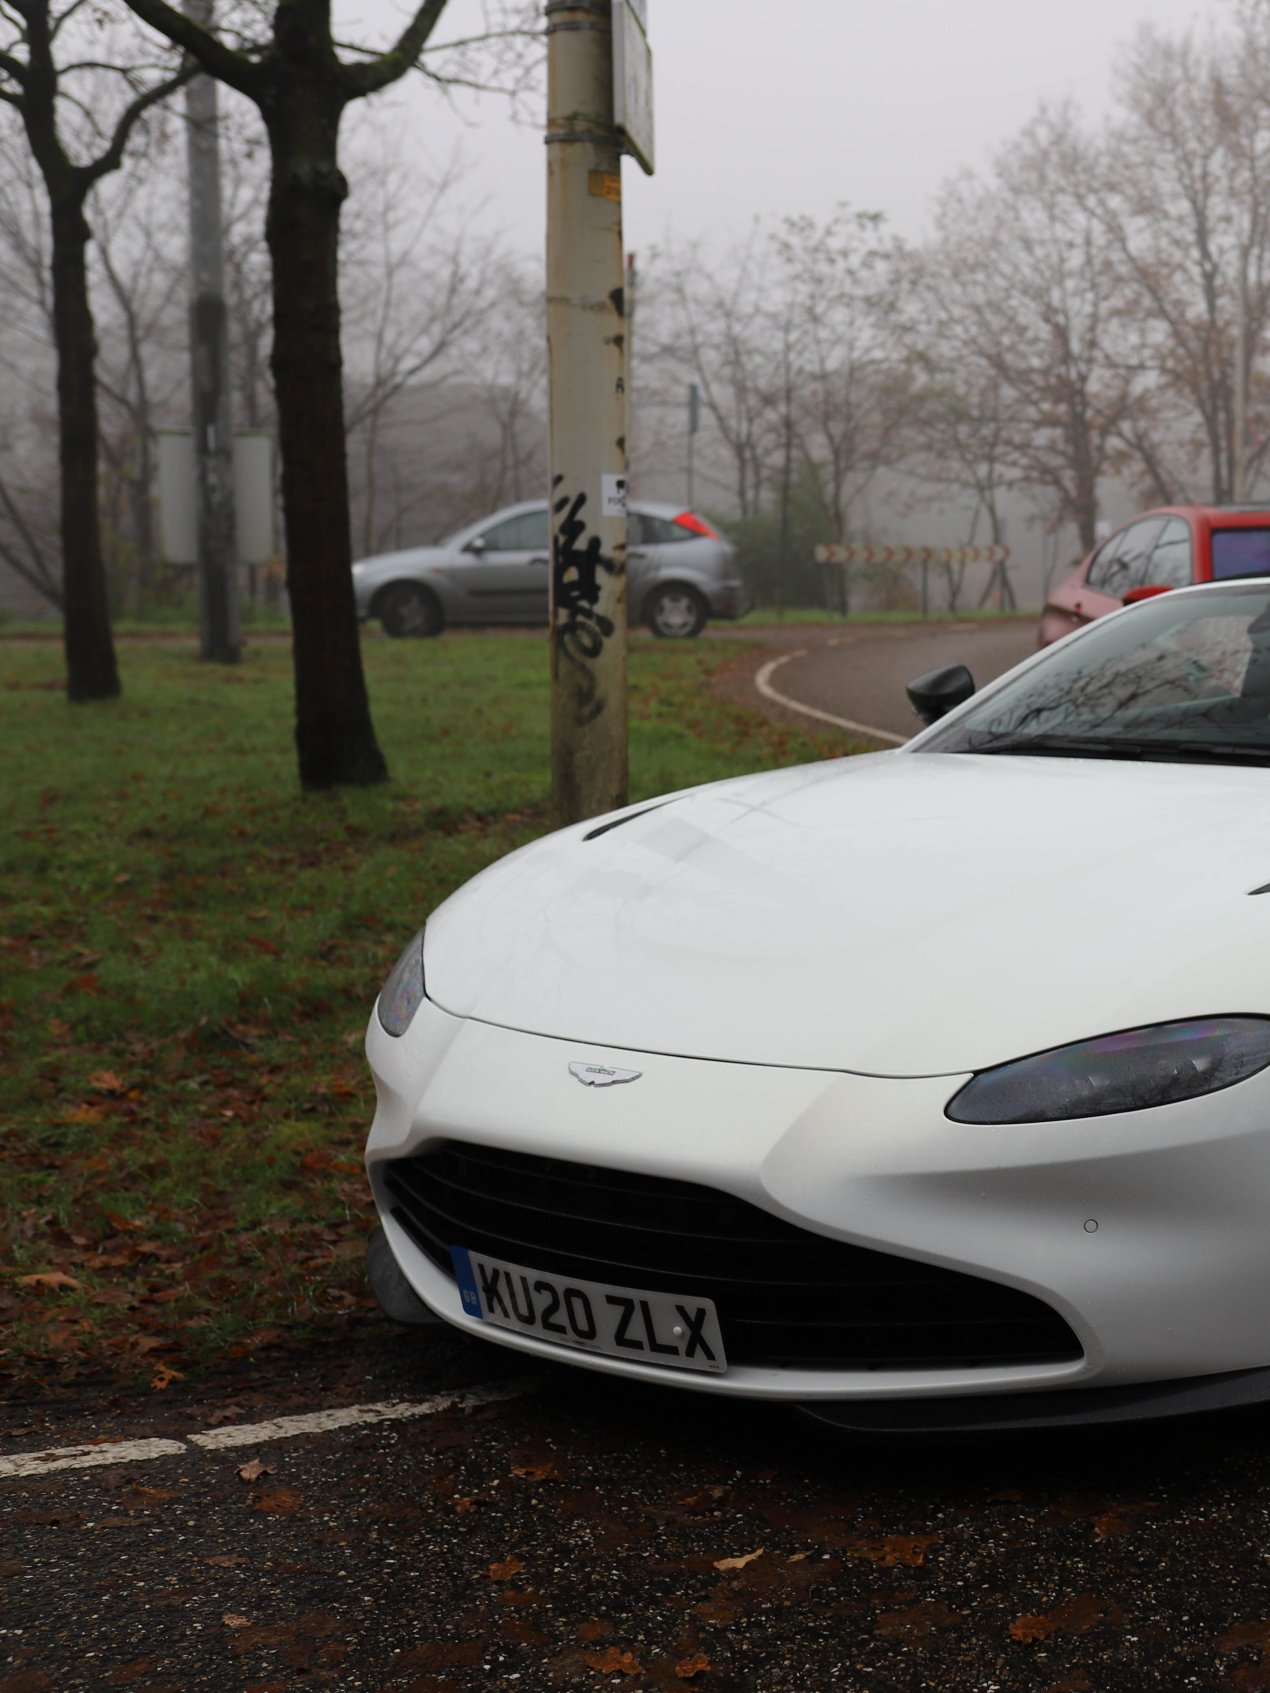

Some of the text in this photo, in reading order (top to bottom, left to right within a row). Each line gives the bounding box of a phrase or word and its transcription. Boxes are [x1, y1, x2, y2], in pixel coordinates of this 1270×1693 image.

[463, 1289, 478, 1305] GB
[478, 1263, 716, 1360] KU20 ZLX
